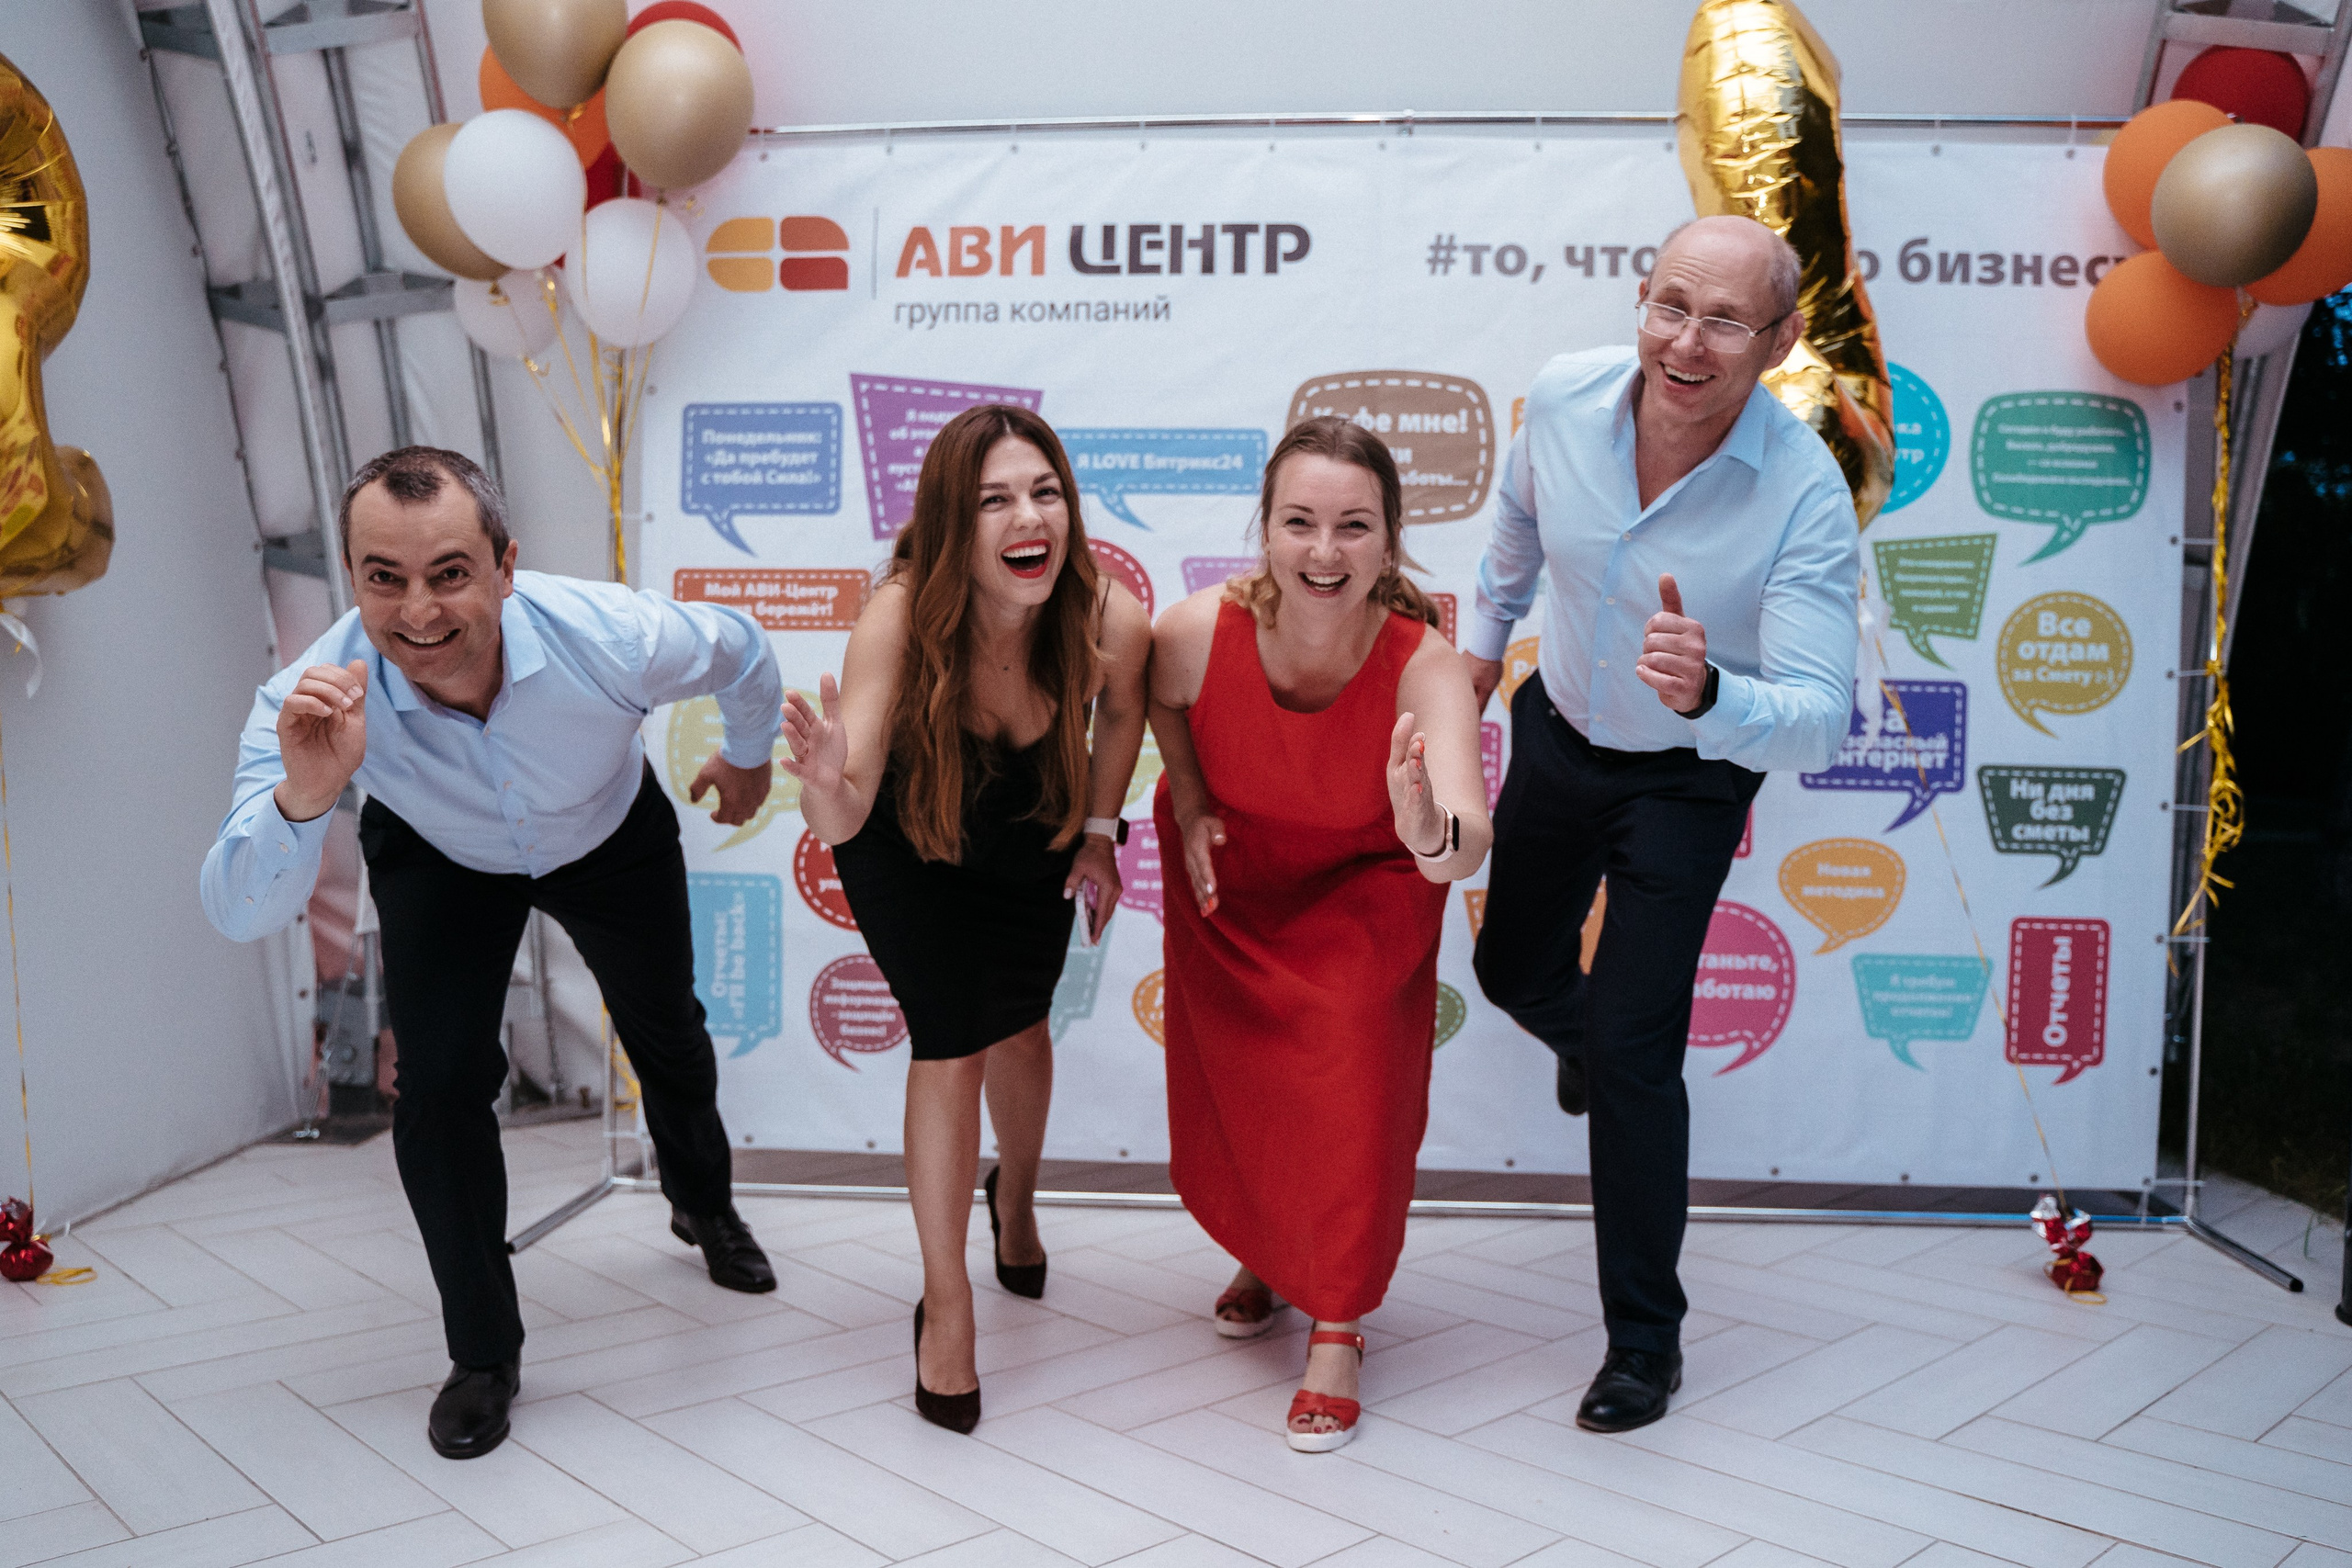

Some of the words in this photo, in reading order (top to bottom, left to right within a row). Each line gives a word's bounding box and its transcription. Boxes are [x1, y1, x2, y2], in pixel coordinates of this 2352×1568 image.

[896, 225, 1046, 277] АВИ
[1069, 224, 1311, 275] ЦЕНТР
[1427, 233, 1546, 284] #то,
[1565, 245, 1658, 277] что
[1898, 236, 2125, 287] бизнес
[895, 301, 1000, 330] группа
[1011, 296, 1171, 321] компаний
[1397, 408, 1468, 434] мне!
[1092, 453, 1141, 469] LOVE
[2038, 611, 2093, 638] Все
[2018, 641, 2109, 666] отдам
[1838, 750, 1949, 773] нтернет
[2009, 778, 2044, 799] Ни
[2047, 783, 2095, 804] дня
[2030, 797, 2074, 821] без
[2011, 823, 2091, 841] сметы
[1698, 953, 1779, 973] таньте,
[1693, 977, 1776, 1000] аботаю
[2042, 936, 2072, 1047] Отчеты
